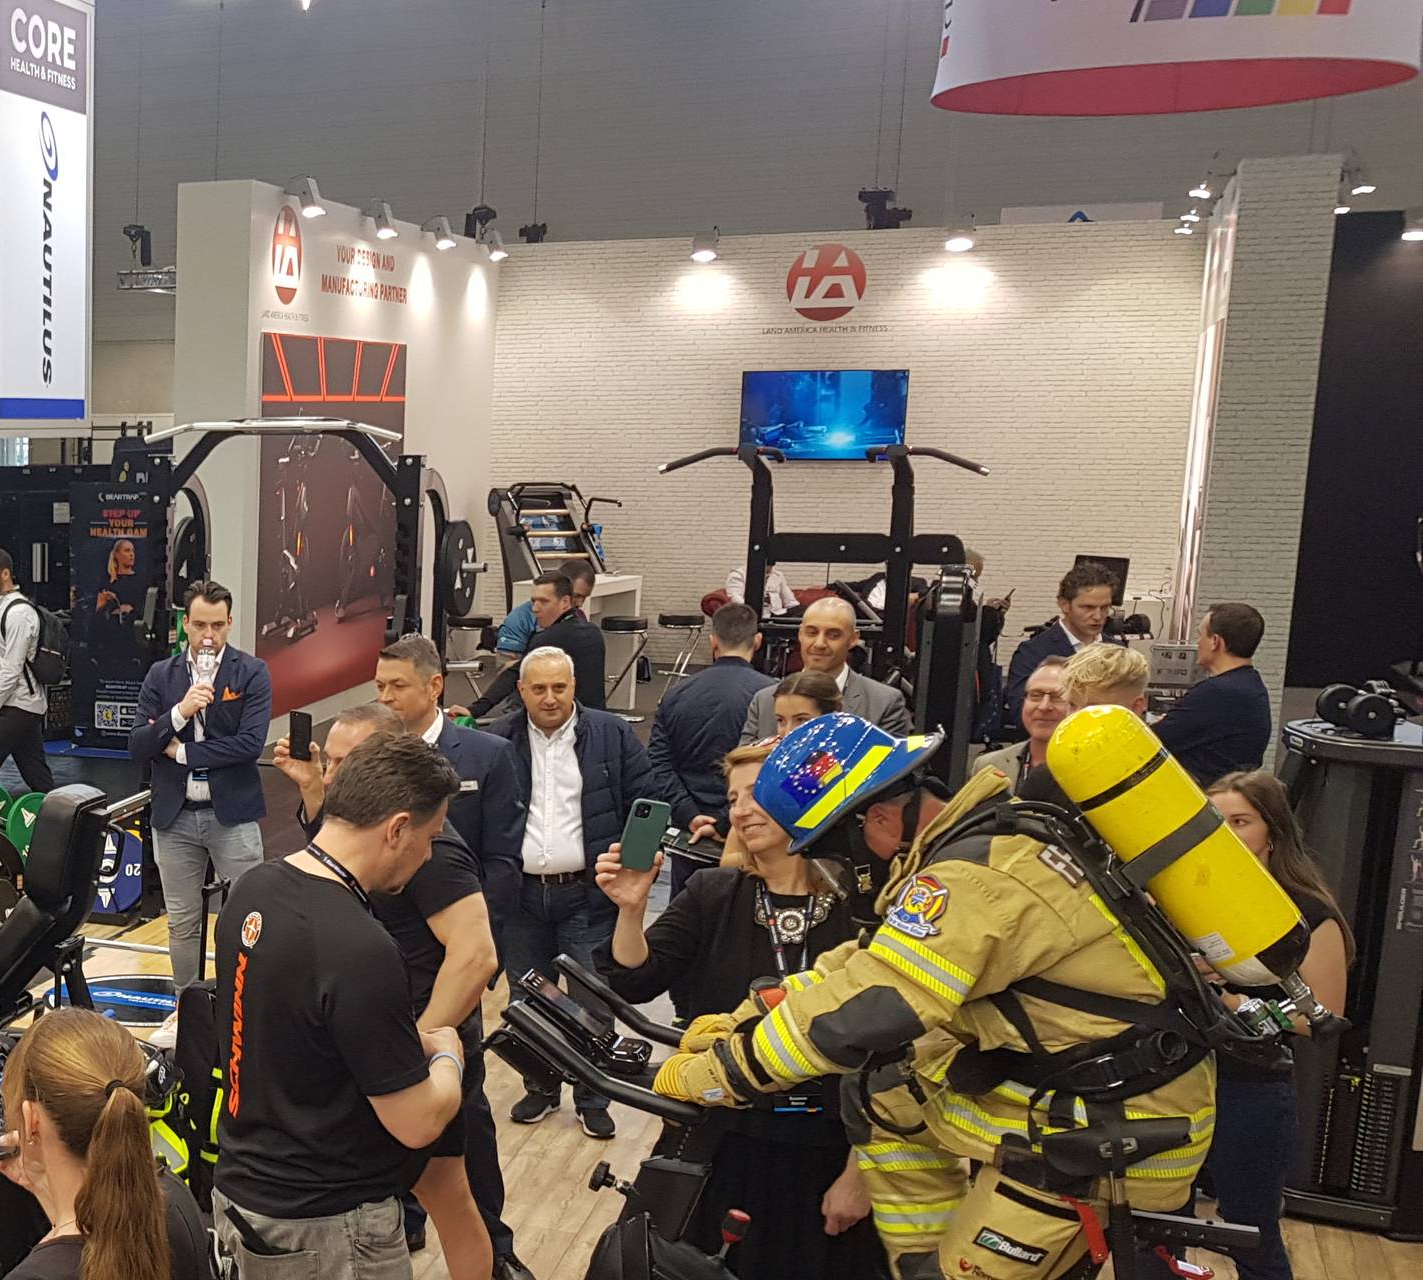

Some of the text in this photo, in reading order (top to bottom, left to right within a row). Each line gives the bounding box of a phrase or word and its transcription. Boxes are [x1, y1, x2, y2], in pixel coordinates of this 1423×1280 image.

[10, 8, 76, 71] CORE
[10, 56, 76, 90] HEALTH & FITNESS
[336, 245, 395, 272] YOUR DESIGN AND
[42, 177, 54, 385] NAUTILUS
[321, 273, 408, 304] MANUFACTURING PARTNER
[762, 327, 783, 335] LAND
[784, 326, 818, 335] AMERICA
[819, 325, 849, 334] HEALTH
[858, 324, 889, 333] FITNESS
[105, 493, 139, 501] BEARTRAP
[102, 509, 142, 519] STEP UP
[108, 519, 135, 527] YOUR
[126, 527, 148, 537] GAM
[125, 863, 142, 877] 20
[228, 951, 248, 1119] SCHWINN
[998, 1240, 1044, 1263] Bullard
